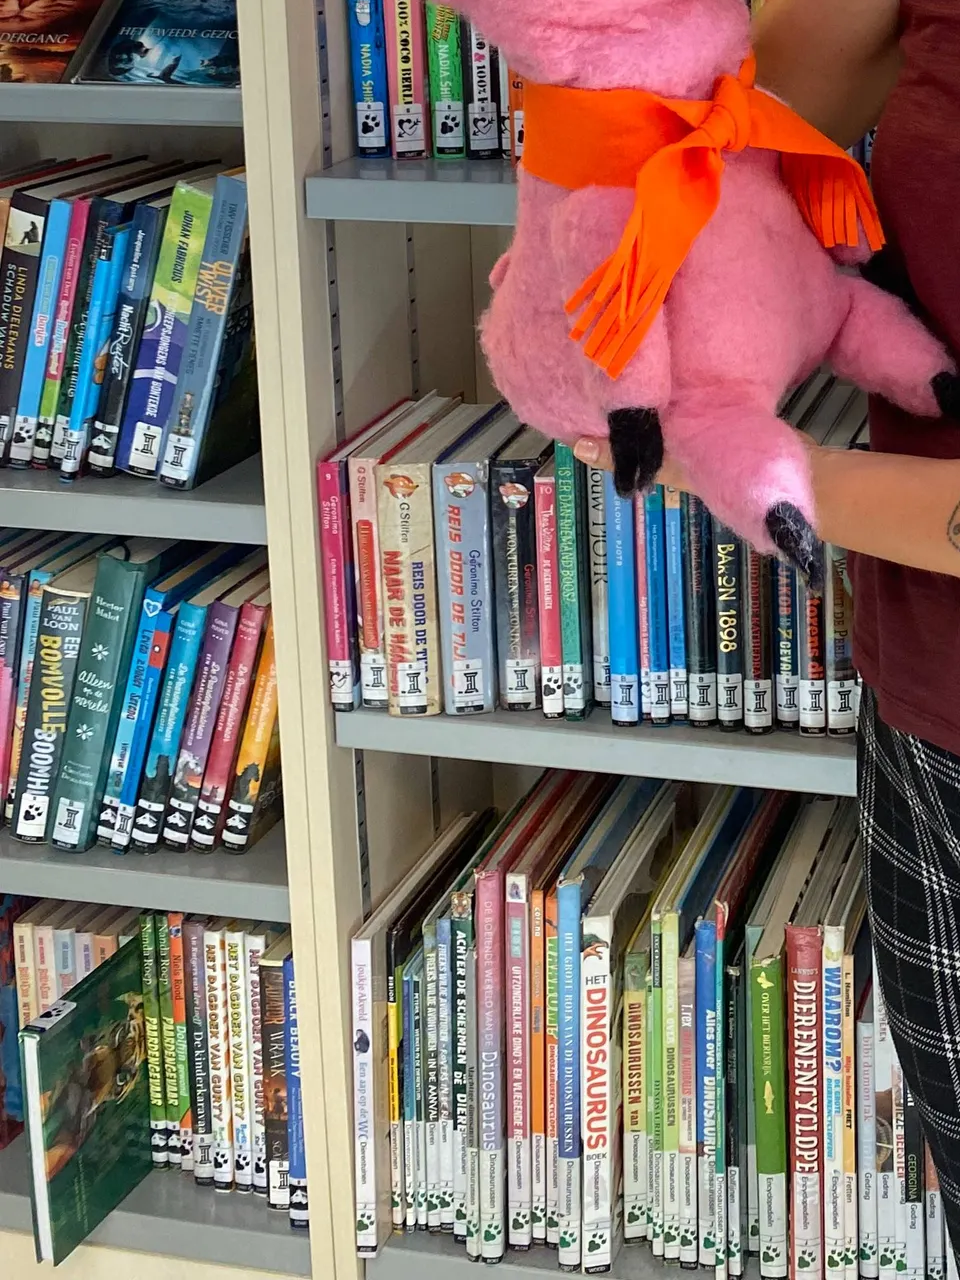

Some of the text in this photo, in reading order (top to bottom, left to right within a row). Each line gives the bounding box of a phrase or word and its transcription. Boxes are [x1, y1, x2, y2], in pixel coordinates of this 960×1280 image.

[119, 26, 198, 38] HET TWEEDE
[360, 43, 371, 77] NADIA
[399, 29, 411, 70] COCO
[439, 44, 449, 79] NADIA
[172, 210, 194, 284] JOHAN FABRICIUS
[2, 263, 16, 320] SCHADUW
[205, 260, 233, 315] OLIVER
[4, 267, 28, 369] LINDA DIELEMANS
[330, 495, 339, 535] Geronimo
[383, 551, 407, 628] NAAR DE
[447, 504, 465, 625] REIS DOOR DE
[469, 549, 483, 633] Geronimo Stilton
[42, 620, 80, 631] LOON
[47, 606, 80, 615] PAUL
[96, 596, 124, 612] Hector
[96, 607, 119, 622] Malot
[412, 561, 427, 646] REIS DOOR DE
[719, 609, 738, 653] 1898
[806, 596, 820, 657] torens
[63, 636, 80, 659] EEN
[39, 634, 66, 733] BOMVOLLE
[78, 670, 113, 691] Alleen
[456, 930, 467, 1065] ACHTER SCHERMEN
[512, 965, 522, 1034] UITZONDERLIJKE
[585, 974, 608, 985] HET
[206, 944, 223, 1122] HET DAGBOEK VAN GURTY
[228, 942, 245, 1121] HET DAGBOEK VAN GURTY
[289, 980, 301, 1078] BLACK BEAUTY
[681, 1003, 694, 1028] T.rex
[705, 1009, 717, 1070] Alles over
[823, 966, 843, 1073] WAAROM?
[270, 1030, 285, 1077] WRAAK
[586, 987, 608, 1150] DINOSAURUS
[627, 1002, 642, 1105] DINOSAURUSSEN
[564, 1067, 574, 1153] DINOSAURUSSEN
[666, 1047, 677, 1127] DINOSAURUSSEN
[358, 1141, 368, 1185] Dierentuinen
[489, 1153, 498, 1209] Dinosaurussen
[586, 1152, 607, 1161] BOEK
[907, 1153, 918, 1201] GEORGINA
[863, 1172, 873, 1201] Gedrag
